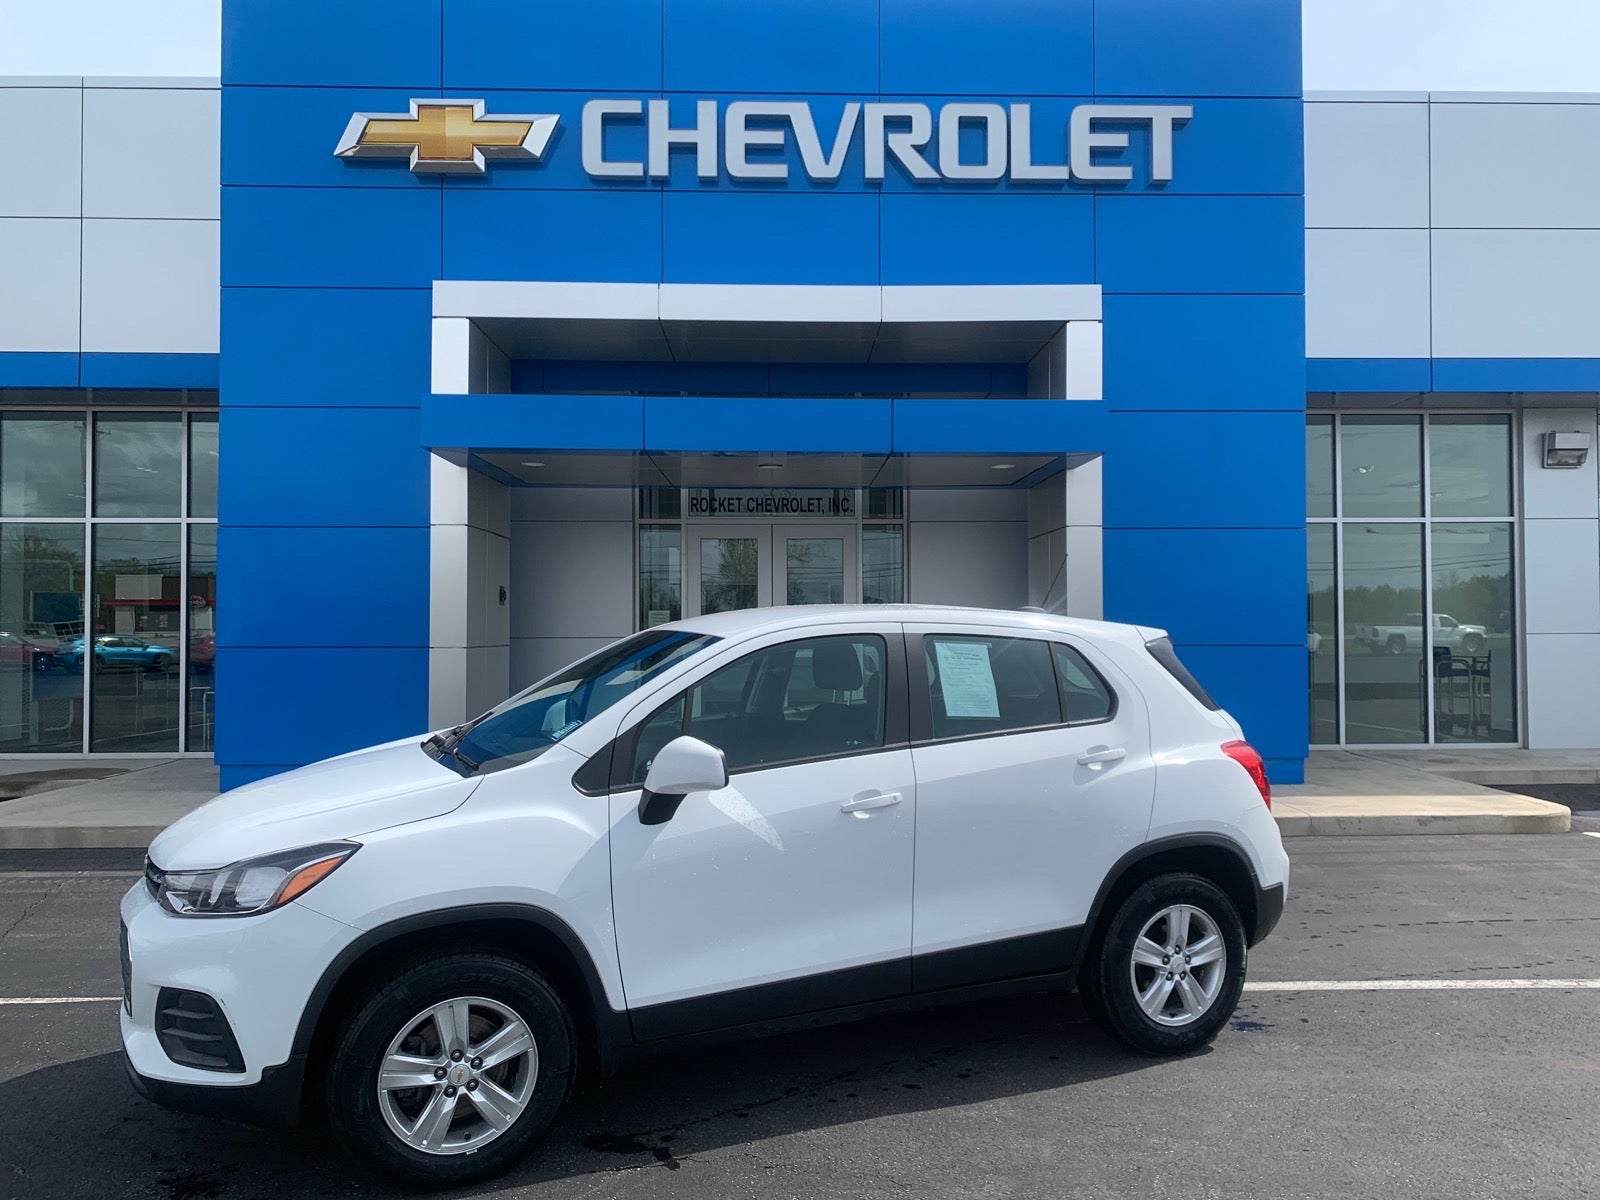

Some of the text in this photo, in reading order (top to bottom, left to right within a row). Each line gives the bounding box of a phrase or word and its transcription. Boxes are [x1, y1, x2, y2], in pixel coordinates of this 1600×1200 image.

[580, 98, 1194, 184] CHEVROLET
[690, 497, 854, 515] ROCKET CHEVROLET, INC.
